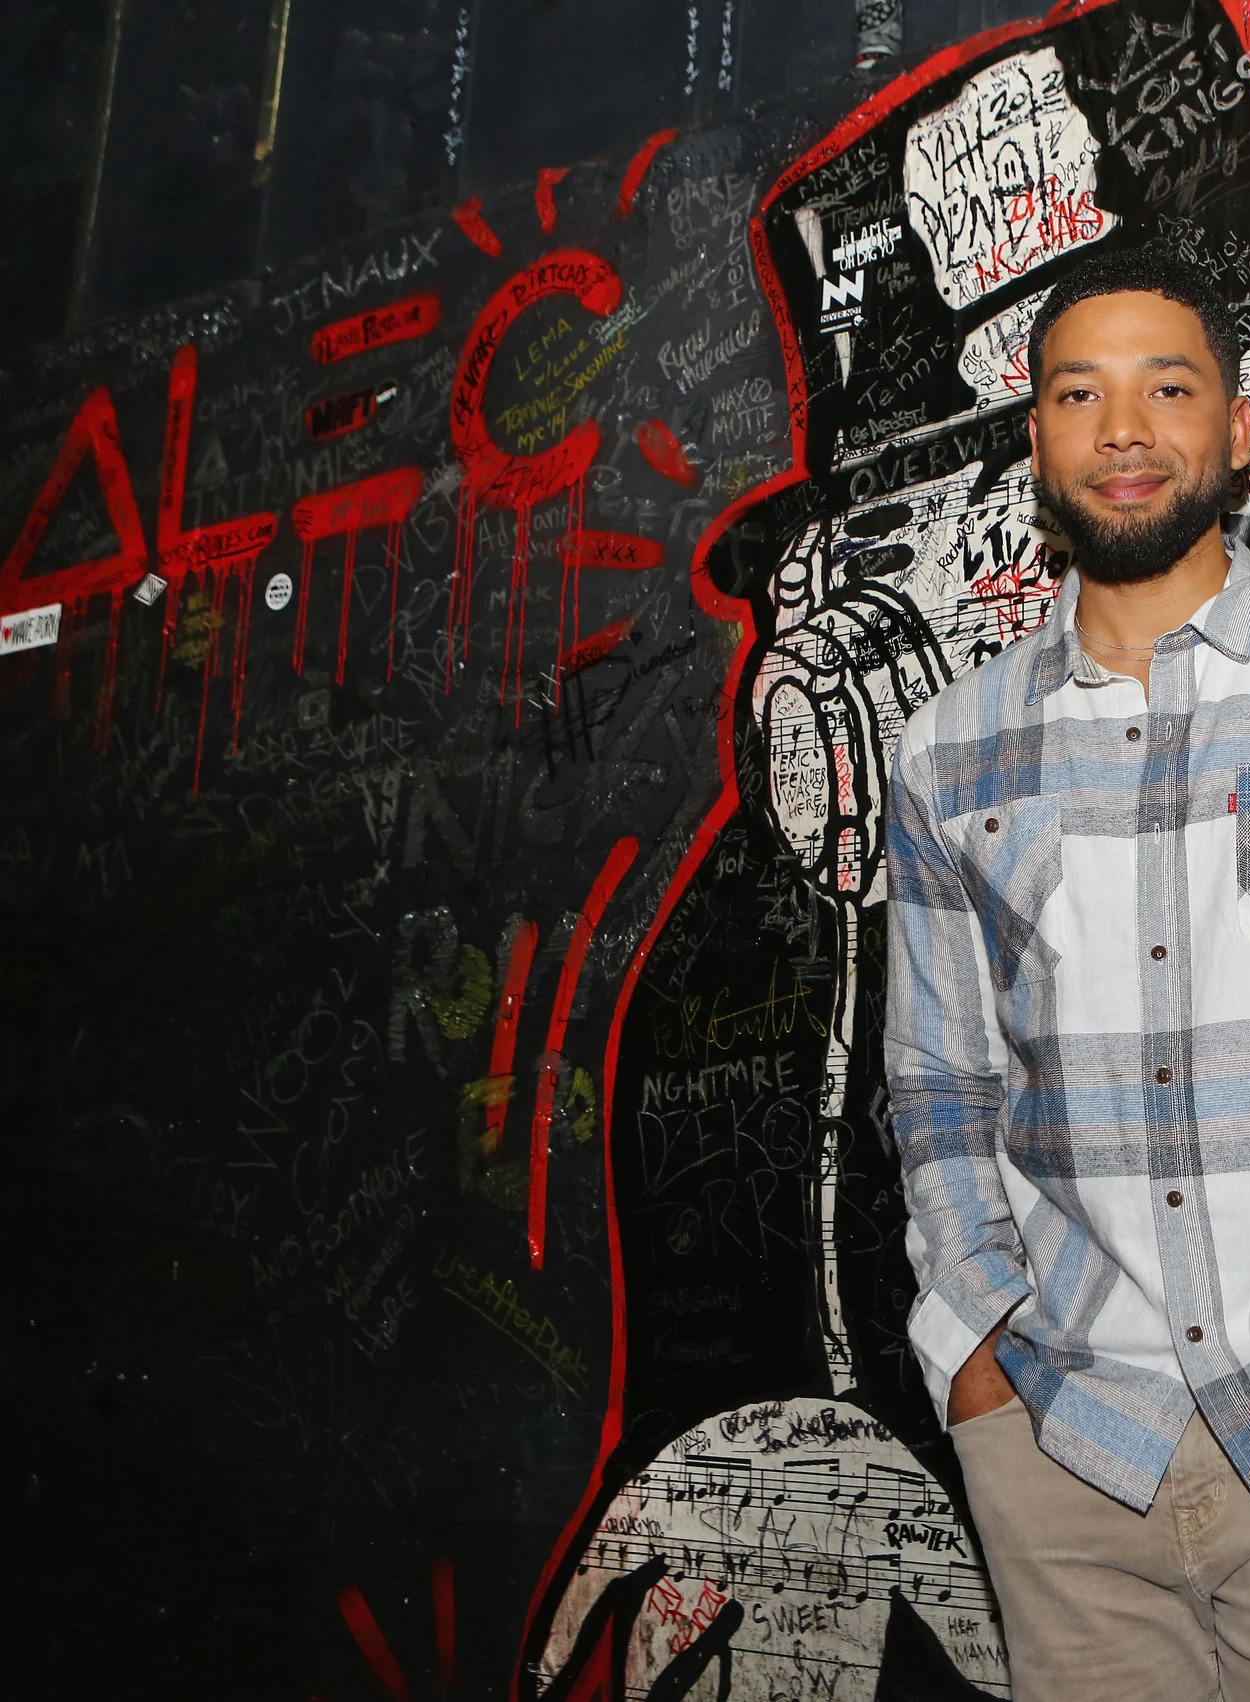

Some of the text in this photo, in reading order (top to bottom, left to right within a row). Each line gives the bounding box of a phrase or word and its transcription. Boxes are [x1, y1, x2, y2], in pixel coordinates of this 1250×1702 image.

[270, 228, 442, 336] JENAUX
[515, 318, 572, 381] LEMA
[850, 412, 1030, 503] OVERWER
[778, 766, 827, 791] FENDER
[779, 750, 811, 772] ERIC
[782, 785, 812, 803] WAS
[787, 794, 823, 820] HERE
[641, 1050, 801, 1114] NGHTMRE
[883, 1521, 967, 1559] RAWTEK
[753, 1600, 843, 1643] SWEET
